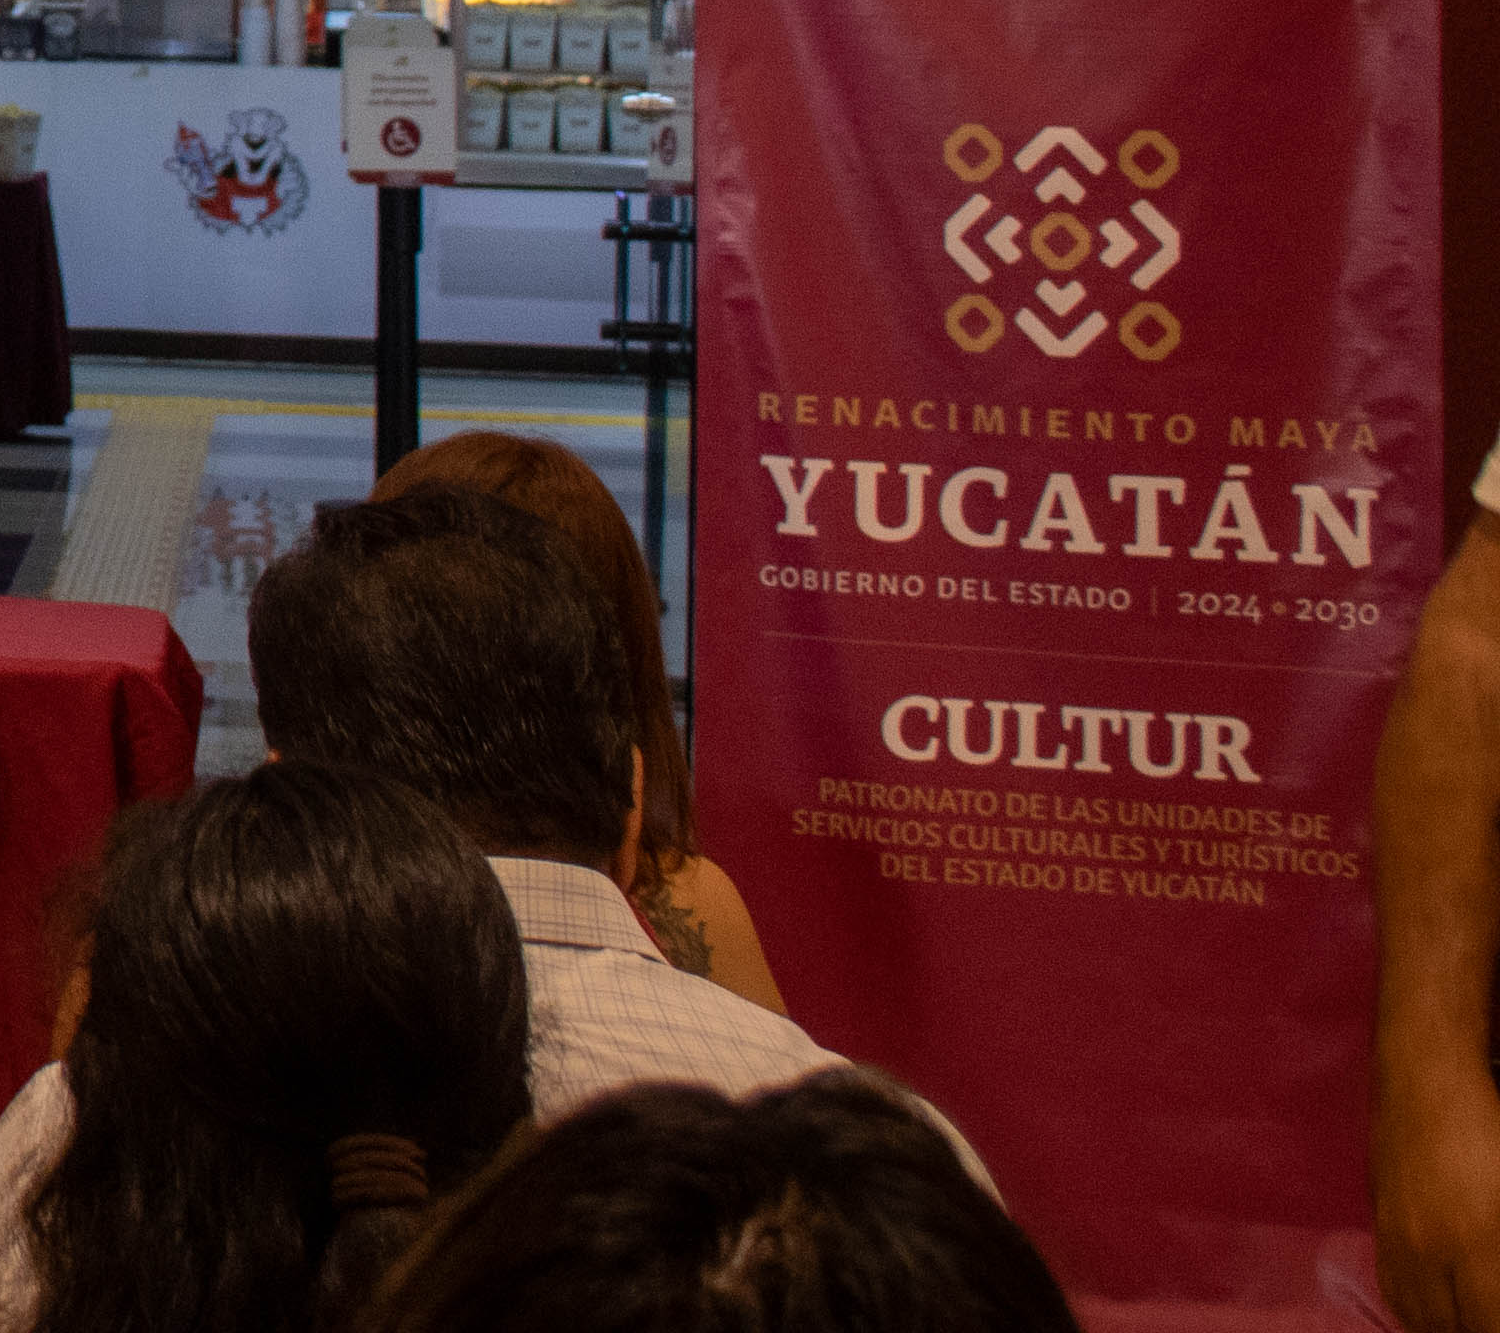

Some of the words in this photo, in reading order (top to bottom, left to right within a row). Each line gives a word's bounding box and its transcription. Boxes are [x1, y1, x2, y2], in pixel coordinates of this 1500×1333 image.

[760, 391, 1197, 446] RENACIMIENTO
[1228, 413, 1379, 454] MAYA
[760, 454, 1380, 569] YUCATÁN
[760, 563, 925, 599] GOBIERNO
[937, 577, 998, 602] DEL
[1008, 580, 1133, 612] ESTADO
[1177, 589, 1263, 623] 2024
[1294, 597, 1381, 631] 2030
[880, 693, 1262, 784] CULTUR
[819, 776, 999, 818] PATRONATO
[1005, 792, 1047, 820] DE
[1054, 796, 1111, 826] LAS
[1117, 800, 1283, 836] UNIDADES
[1290, 811, 1332, 842] DE
[792, 808, 945, 849] SERVICIOS
[948, 821, 1148, 862] CULTURALES
[1151, 835, 1170, 864] Y
[1169, 832, 1361, 880] TURÍSTICOS
[880, 850, 938, 883] DEL
[944, 856, 1067, 891] ESTADO
[1073, 864, 1116, 894] DE
[1119, 866, 1266, 907] YUCATÁN
